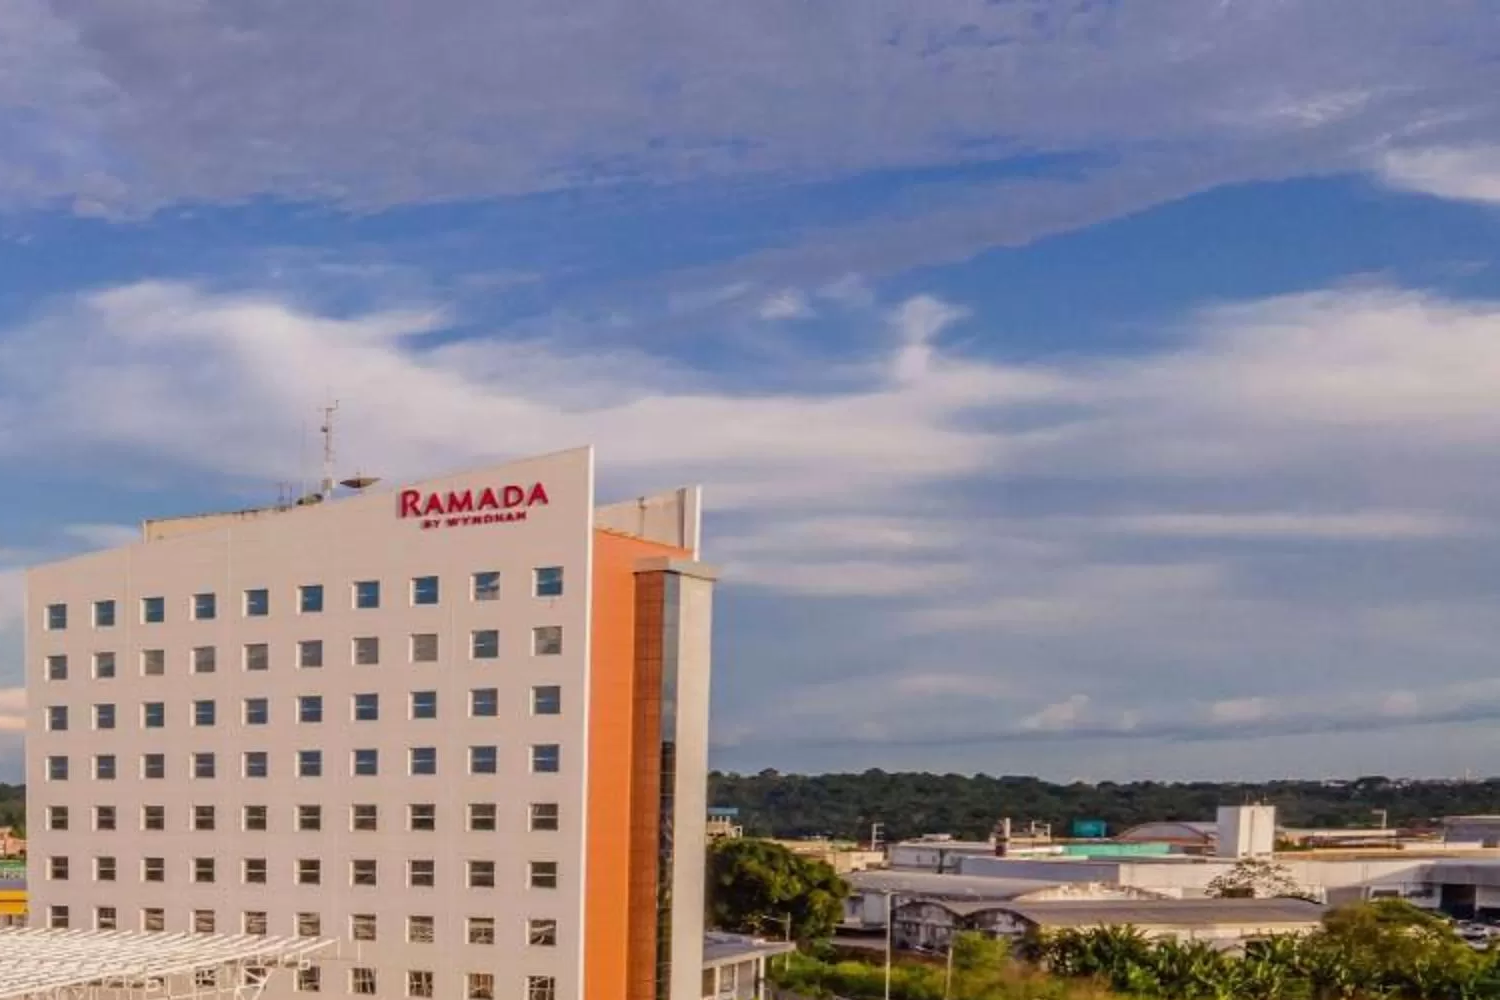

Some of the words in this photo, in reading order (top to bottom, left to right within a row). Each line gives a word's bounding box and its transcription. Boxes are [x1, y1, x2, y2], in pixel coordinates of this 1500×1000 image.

[399, 481, 549, 518] RAMADA
[422, 519, 440, 529] BY
[446, 511, 527, 528] WYNDHAM
